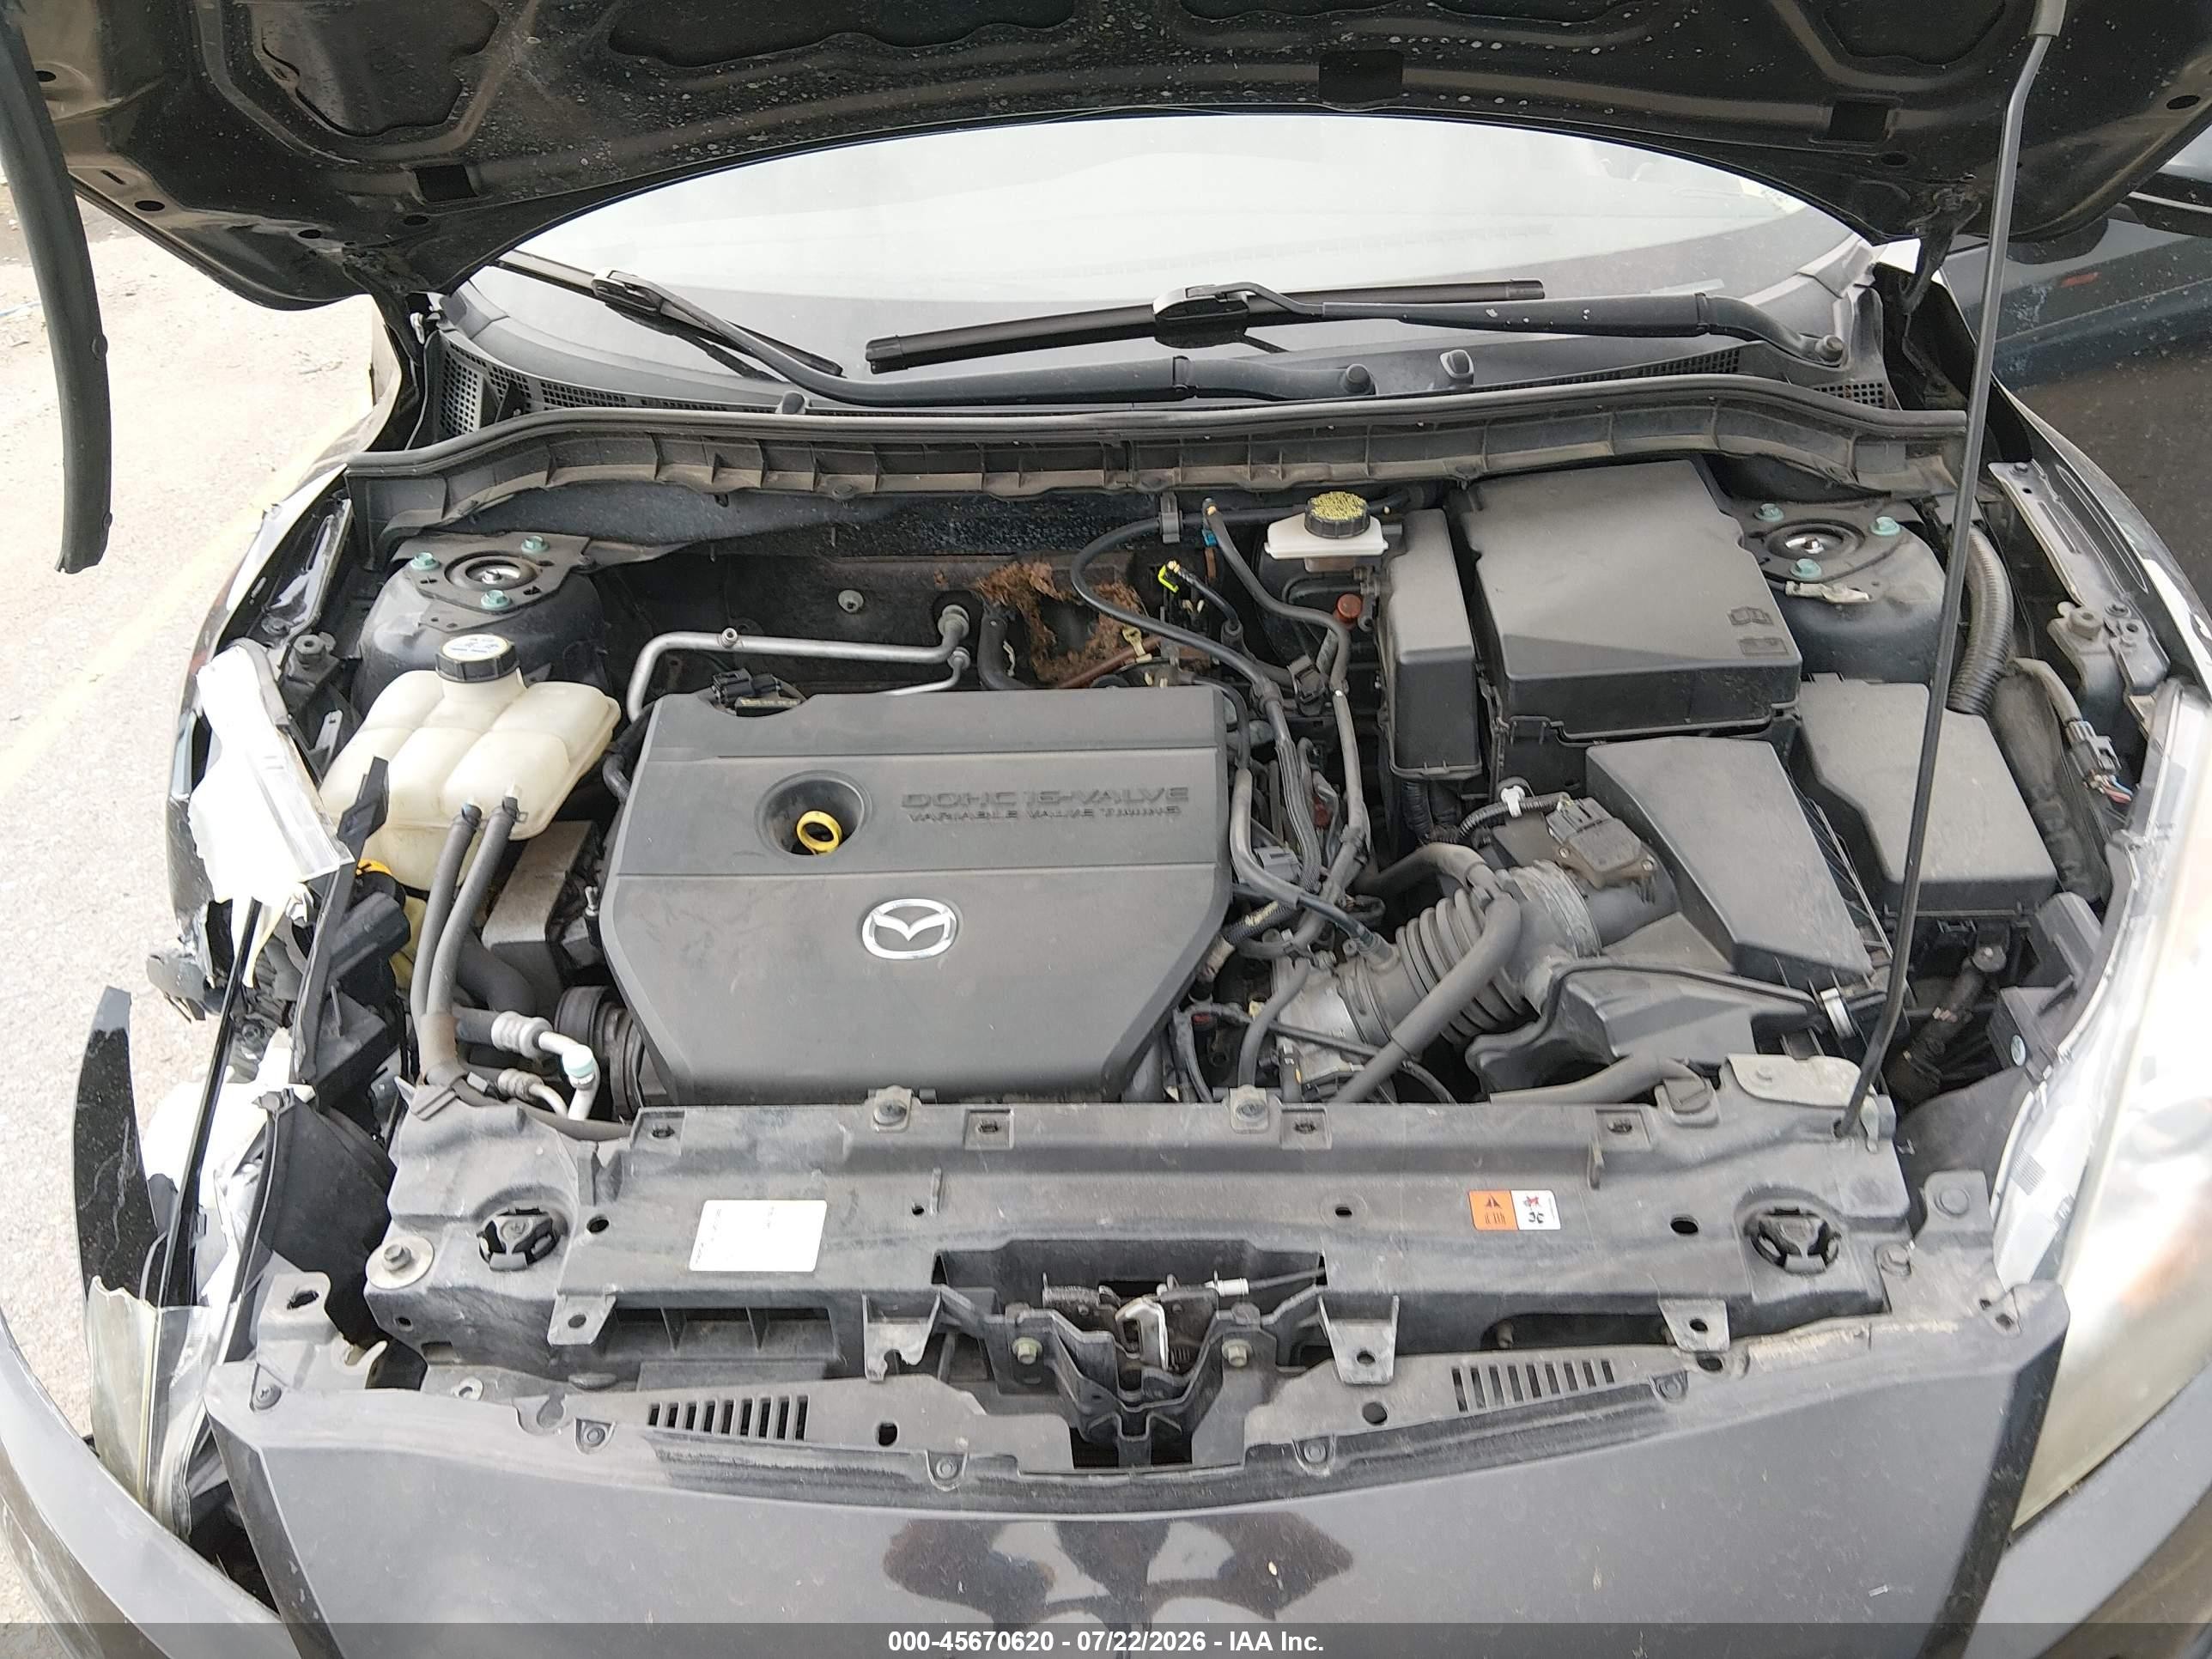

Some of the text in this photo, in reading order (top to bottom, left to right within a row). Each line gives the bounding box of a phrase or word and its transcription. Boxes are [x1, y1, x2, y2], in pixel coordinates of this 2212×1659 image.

[903, 787, 1189, 808] DOHC 16-VALVE
[1028, 807, 1094, 820] VALVE
